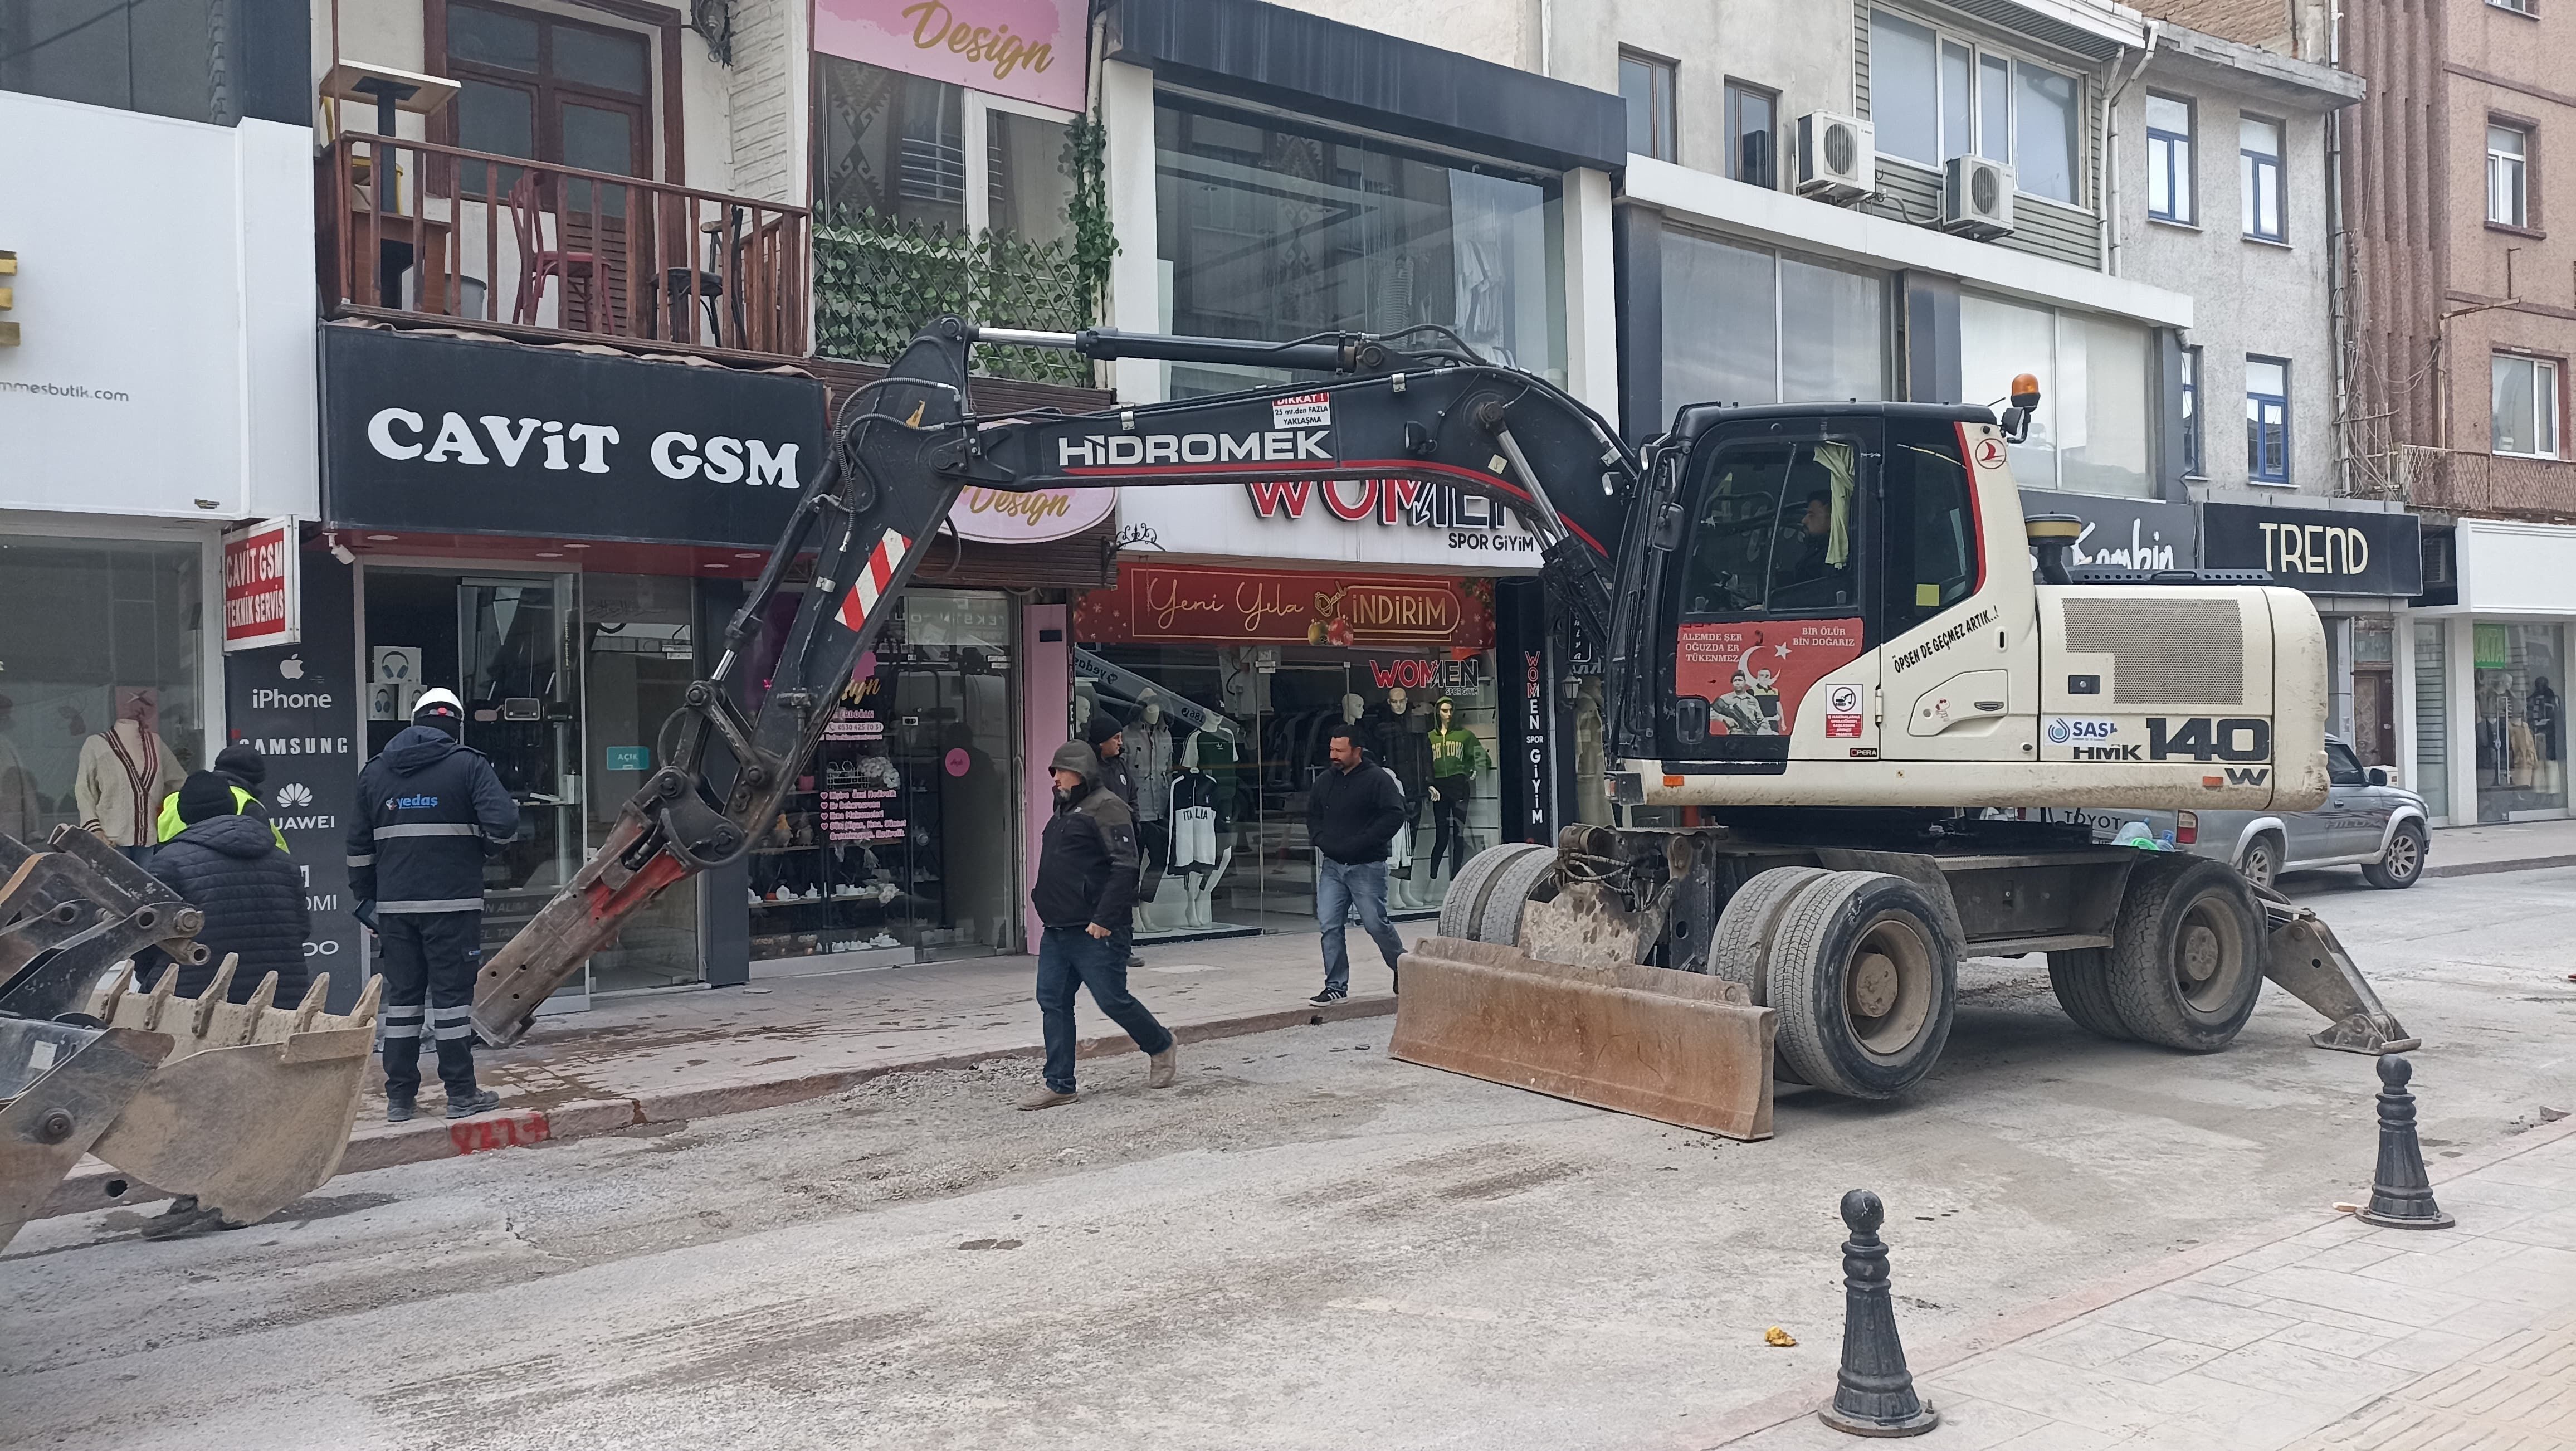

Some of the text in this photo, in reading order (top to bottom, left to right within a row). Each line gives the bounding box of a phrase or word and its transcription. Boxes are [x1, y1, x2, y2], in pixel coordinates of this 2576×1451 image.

[901, 0, 1055, 80] Design
[1283, 416, 1322, 425] YAKLAŞMA
[651, 431, 801, 489] GSM
[962, 484, 1071, 527] Design
[1448, 532, 1489, 551] SPOR
[259, 540, 284, 582] GSM
[255, 584, 284, 624] SERVİS
[1148, 577, 1224, 630] Yeni
[1236, 581, 1304, 632] Yıla
[1724, 633, 1743, 642] ŞER
[1802, 626, 1846, 635] BİR ÖLÜR
[1685, 643, 1739, 652] OĞUZDA ER
[1812, 637, 1855, 646] DOĞARIZ
[1892, 648, 1920, 674] ÖPSEN
[1920, 641, 1933, 659] DE
[1933, 623, 1966, 650] GEÇMEZ
[1685, 654, 1739, 663] TÜKENMEZ
[1369, 659, 1479, 689] WOMEN
[252, 689, 332, 709] iPhone
[1445, 687, 1461, 695] SPOR
[1525, 650, 1540, 731] WOMEN
[1526, 735, 1544, 744] SPOR
[2073, 717, 2270, 761] HMK 140
[618, 753, 638, 762] AÇIK
[2224, 767, 2270, 786] W
[396, 793, 438, 808] yedaş
[271, 815, 335, 830] UAWEI
[2064, 811, 2129, 830] TOYOT
